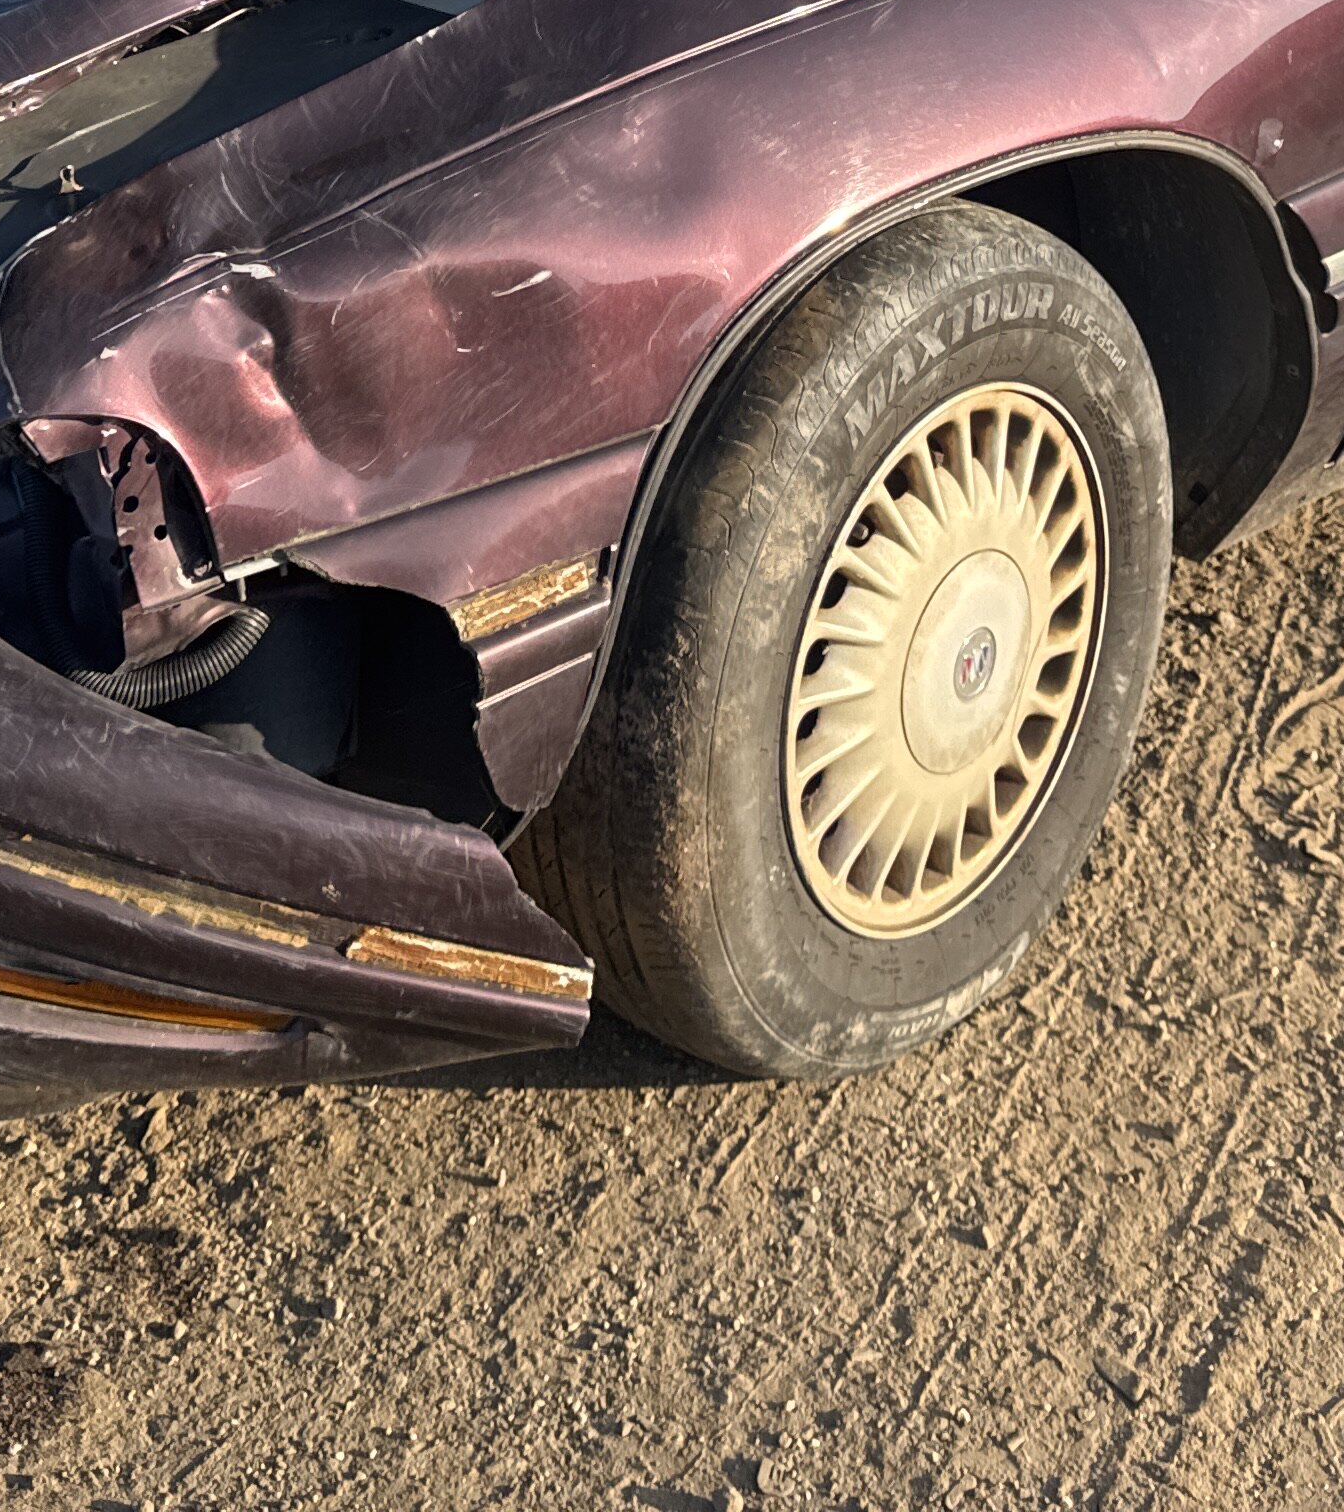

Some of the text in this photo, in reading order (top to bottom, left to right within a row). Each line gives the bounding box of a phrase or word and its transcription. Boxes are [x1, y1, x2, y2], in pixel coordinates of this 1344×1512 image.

[843, 283, 1055, 451] MAXTOUR
[1057, 303, 1082, 328] All
[1079, 314, 1127, 372] Season
